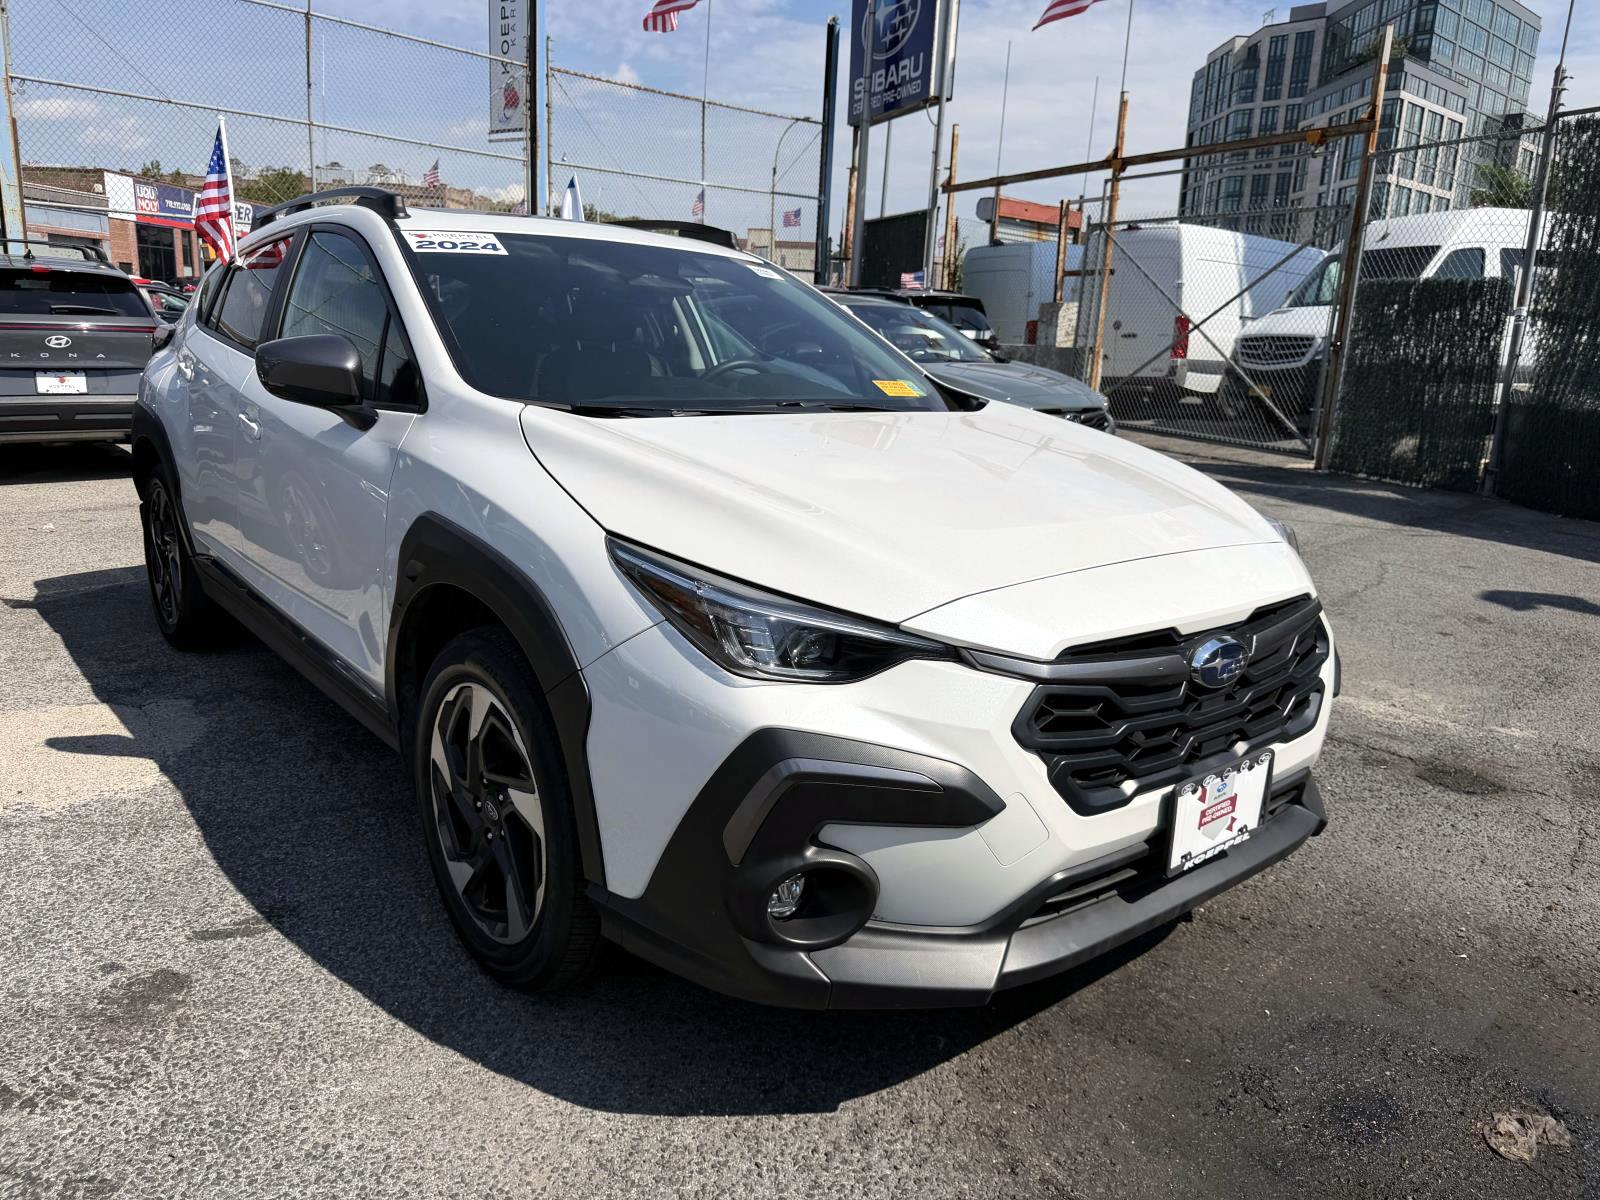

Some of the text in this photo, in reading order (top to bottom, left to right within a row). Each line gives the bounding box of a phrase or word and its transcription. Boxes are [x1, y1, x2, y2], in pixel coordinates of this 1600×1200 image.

[501, 0, 510, 75] KOEP
[137, 199, 160, 212] MOLY
[415, 240, 501, 252] 2024
[1183, 832, 1250, 871] KOEPPEL
